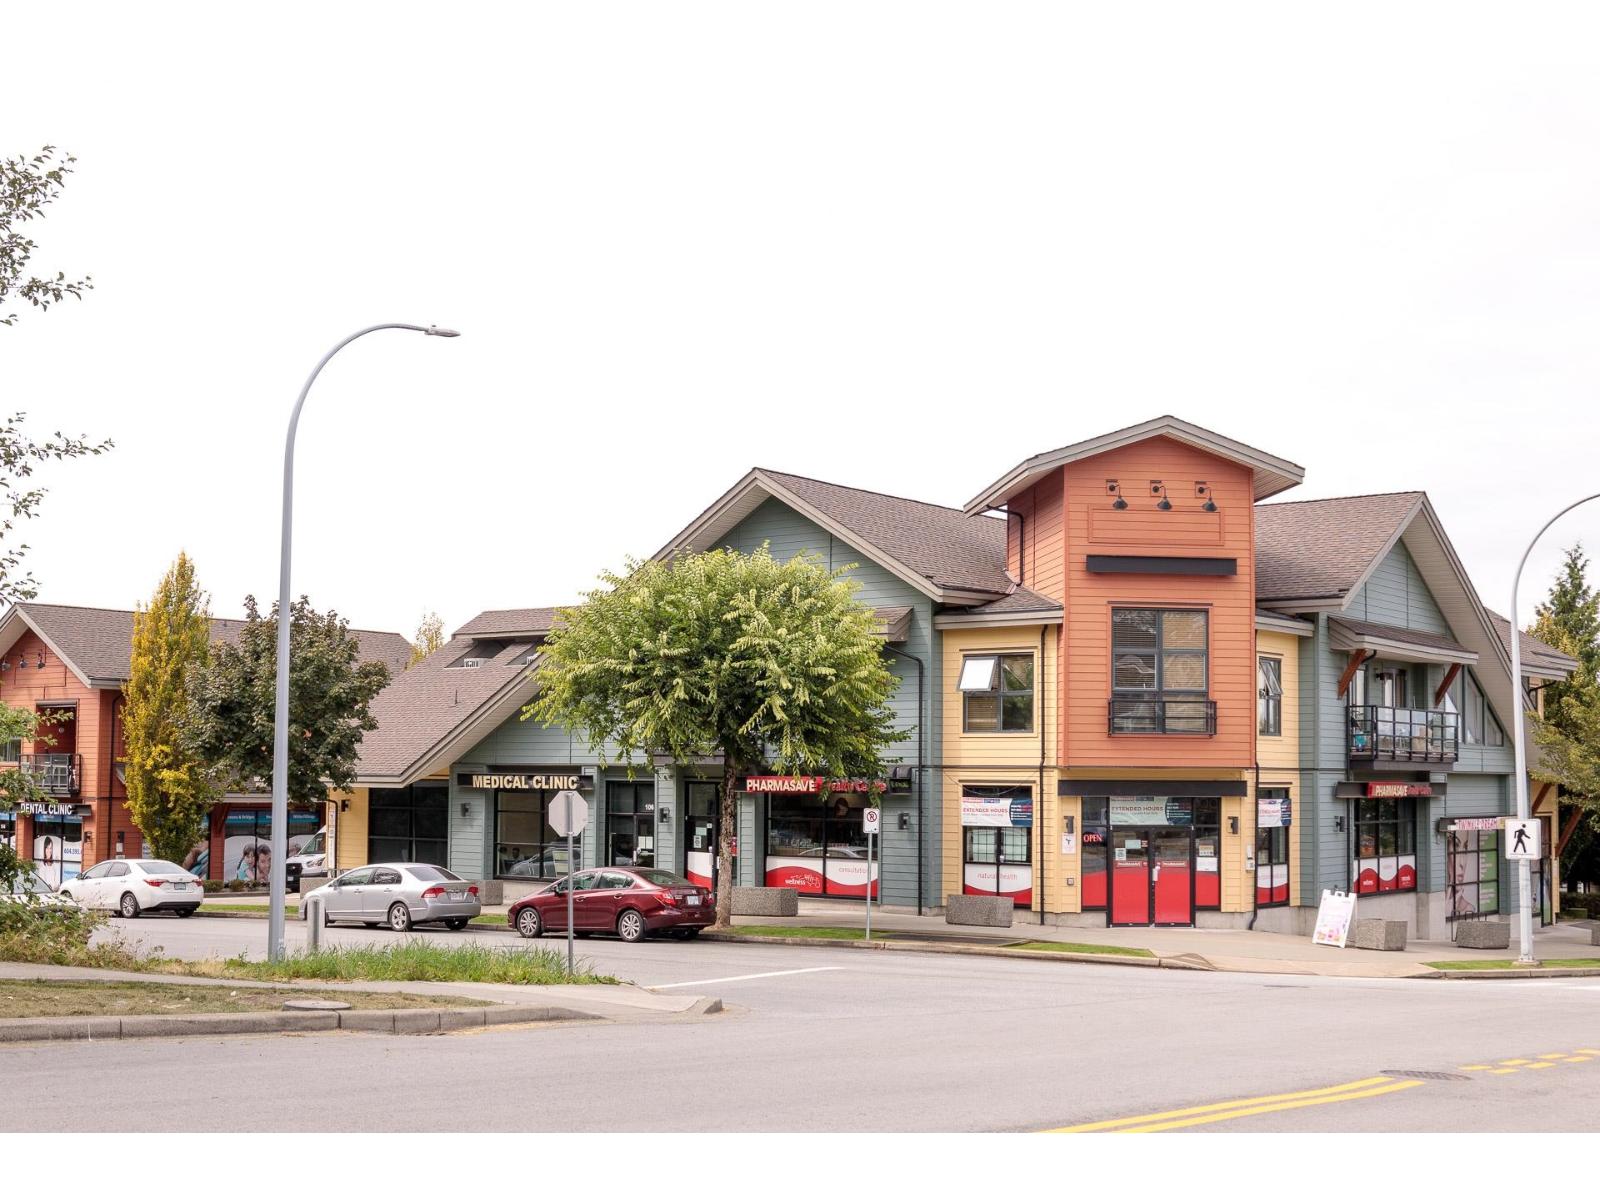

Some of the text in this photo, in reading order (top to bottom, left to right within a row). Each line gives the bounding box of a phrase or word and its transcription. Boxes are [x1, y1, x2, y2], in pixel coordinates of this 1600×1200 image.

[472, 775, 578, 790] MEDICAL CLINIC
[746, 779, 816, 792] PHARMASAVE
[20, 803, 72, 815] DENTAL CLINIC
[1083, 834, 1103, 843] OPEN
